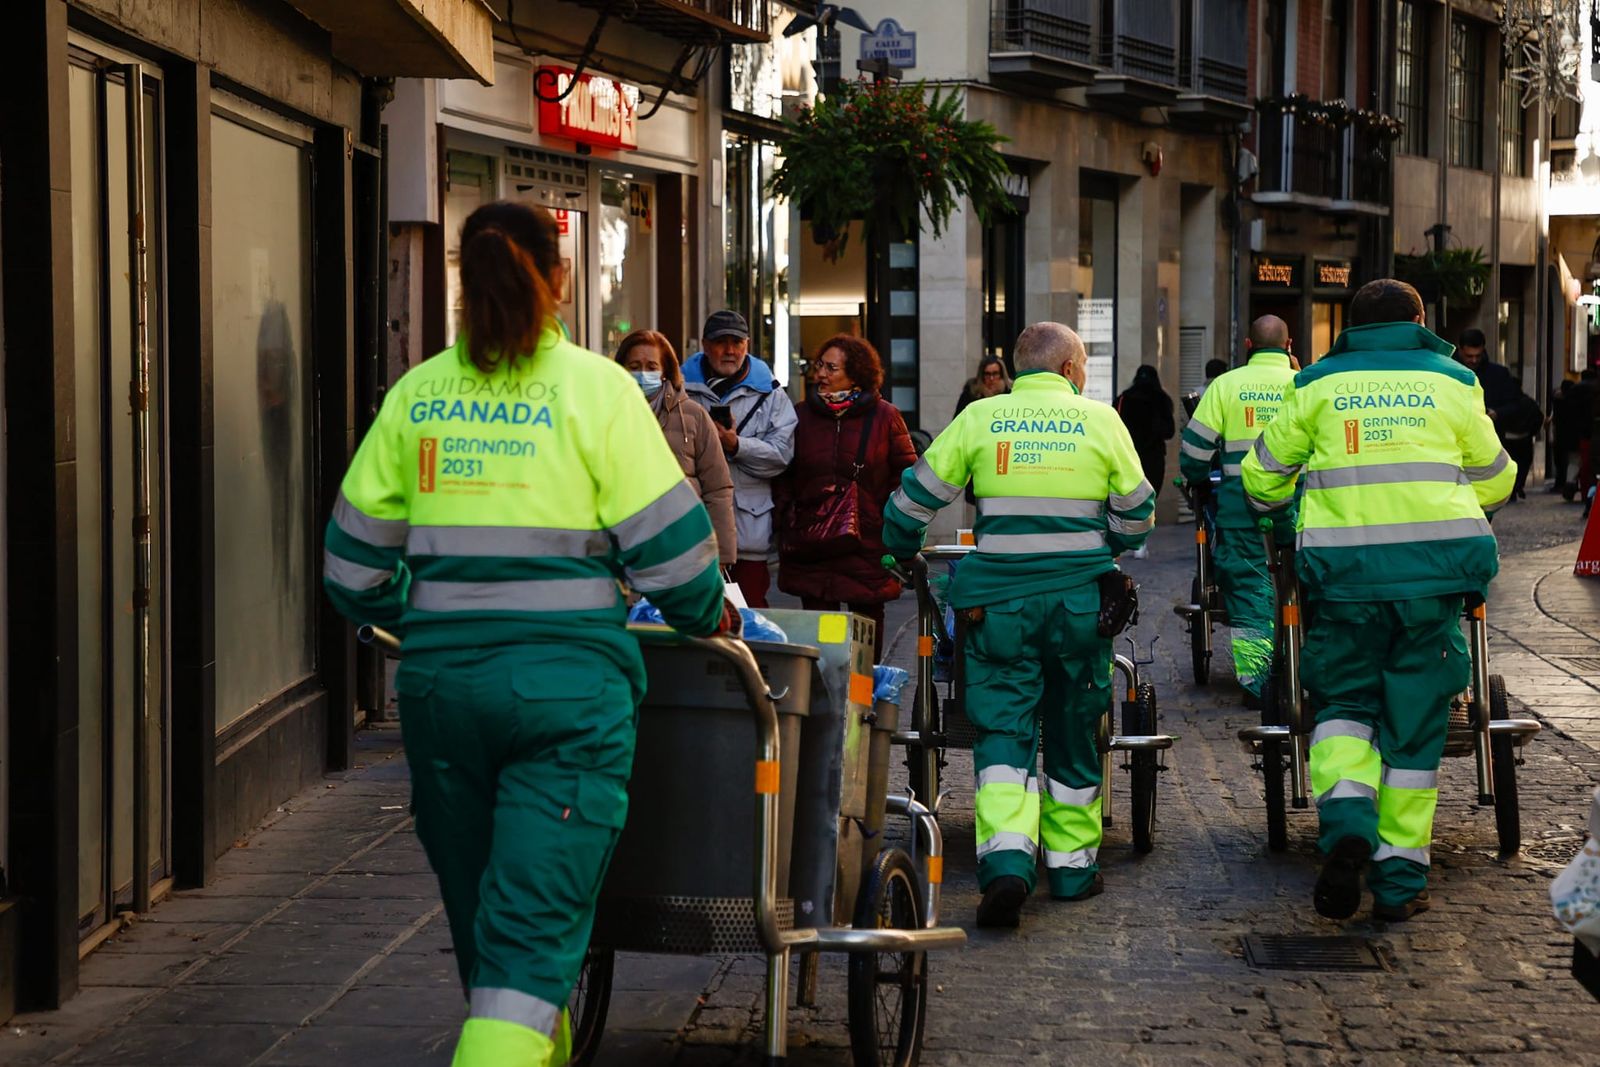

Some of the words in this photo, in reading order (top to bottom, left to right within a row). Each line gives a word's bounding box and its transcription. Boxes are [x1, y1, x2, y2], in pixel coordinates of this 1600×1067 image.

[415, 376, 559, 402] CUIDAMOS
[1240, 383, 1284, 391] CUIDAM
[1334, 381, 1436, 394] CUIDAMOS
[1239, 391, 1283, 401] GRANA
[1334, 394, 1436, 411] GRANADA
[410, 399, 553, 429] GRANADA
[992, 407, 1088, 420] CUIDAMOS
[990, 420, 1085, 436] GRANADA
[1363, 416, 1426, 428] GRANADA
[1364, 429, 1393, 441] 2031
[443, 437, 536, 457] GRANADA
[1014, 441, 1076, 452] GRANADA
[1013, 453, 1042, 464] 2031
[441, 458, 483, 477] 2031
